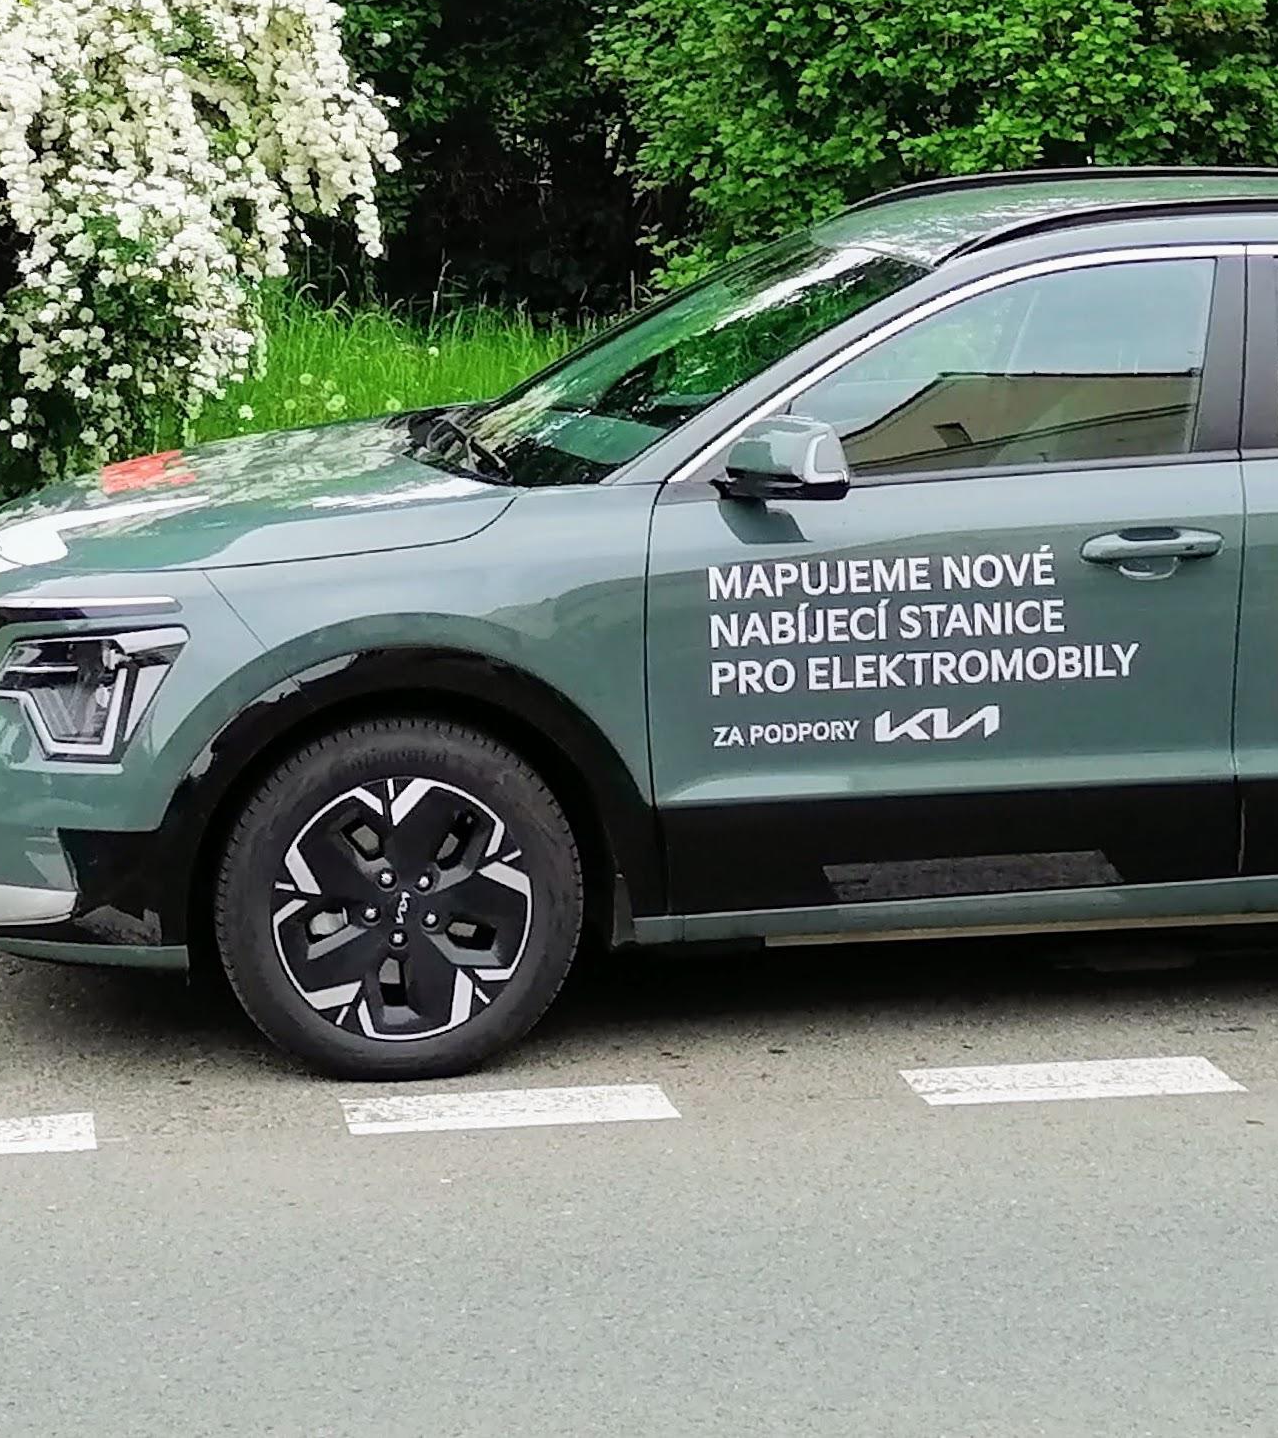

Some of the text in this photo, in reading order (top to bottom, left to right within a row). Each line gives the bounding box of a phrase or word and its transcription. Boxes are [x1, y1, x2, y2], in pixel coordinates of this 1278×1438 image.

[708, 545, 1056, 601] MAPUJEME NOVÉ
[709, 599, 1065, 649] NABÍJECÍ STANICE
[711, 643, 1140, 696] PRO ELEKTROMOBILY
[713, 726, 745, 747] ZA
[750, 719, 861, 745] PODPORY
